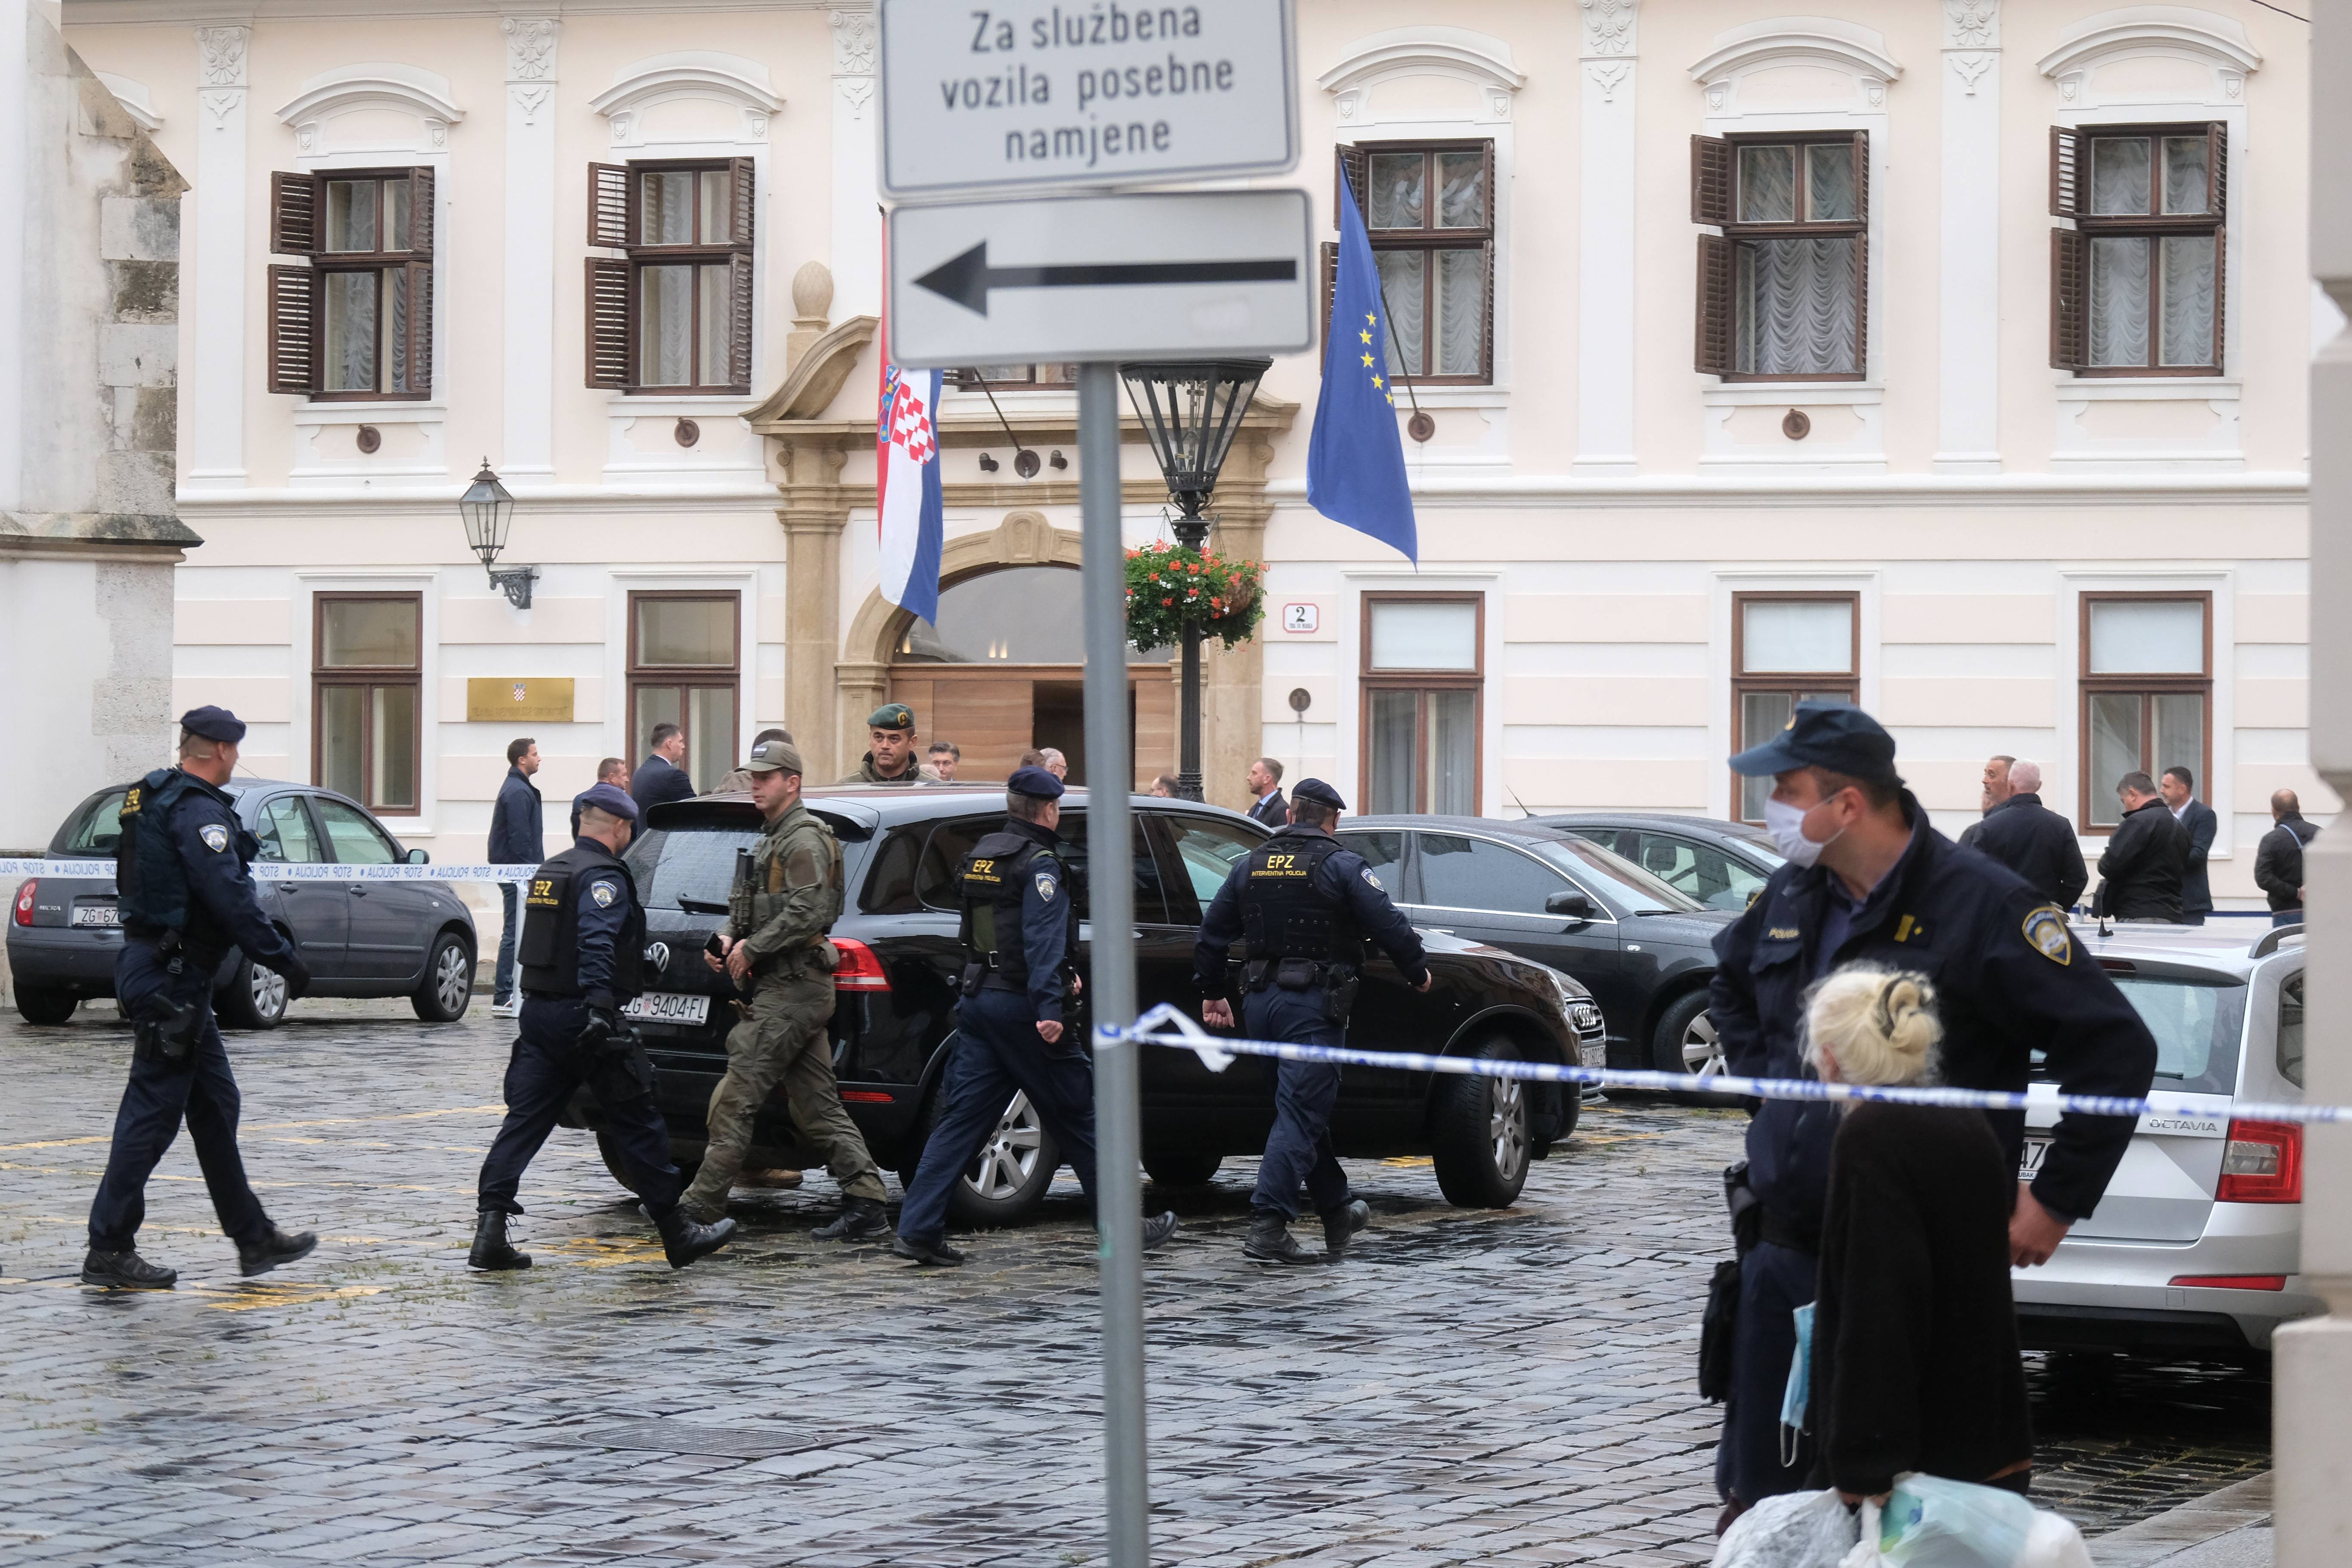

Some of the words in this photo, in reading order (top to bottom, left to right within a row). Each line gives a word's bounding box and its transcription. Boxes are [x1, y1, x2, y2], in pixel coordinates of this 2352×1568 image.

[971, 11, 1015, 53] Za
[1032, 3, 1201, 49] službena
[941, 65, 1050, 109] vozila
[1078, 54, 1233, 111] posebne
[1006, 114, 1170, 166] namjene
[1296, 606, 1305, 622] 2
[972, 860, 994, 873] EPZ
[1267, 855, 1295, 869] EPZ
[534, 881, 552, 896] EPZ
[82, 909, 96, 922] ZG
[2149, 1118, 2217, 1132] OCTAVIA
